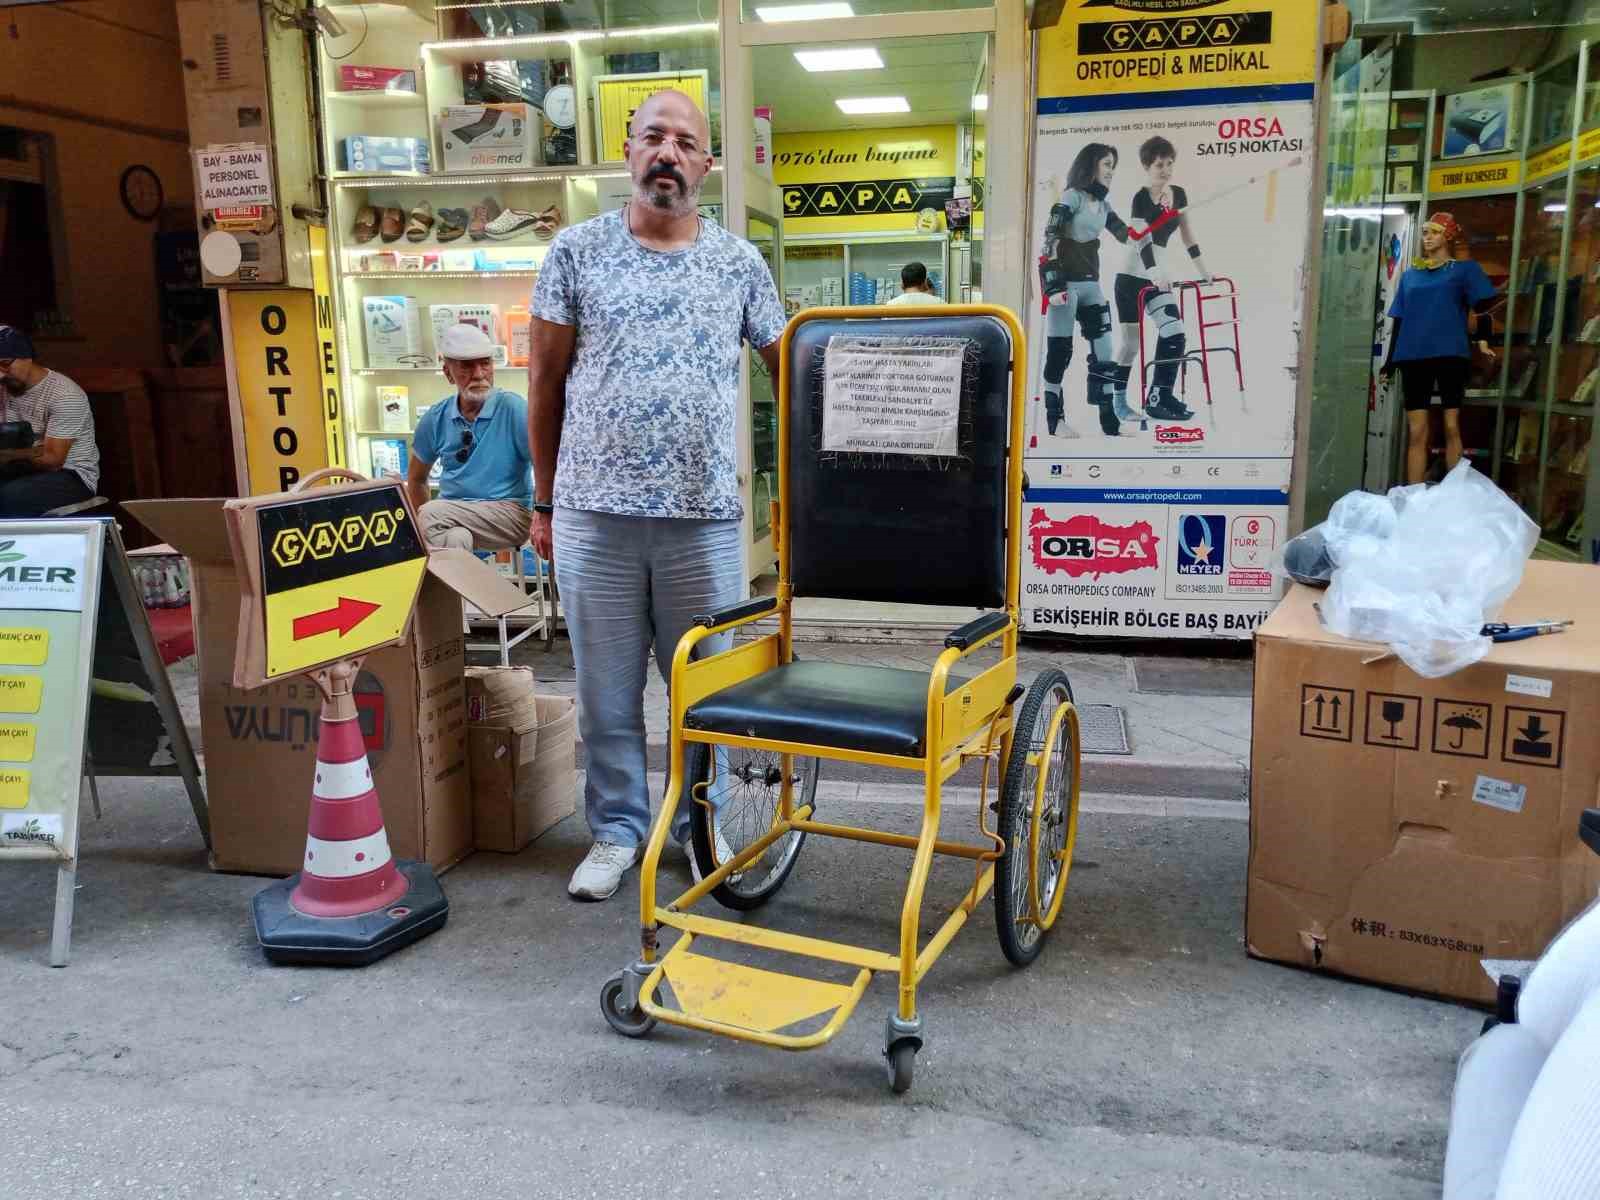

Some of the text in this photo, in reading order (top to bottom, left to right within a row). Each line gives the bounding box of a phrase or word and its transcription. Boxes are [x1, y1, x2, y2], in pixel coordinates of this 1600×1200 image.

[1113, 23, 1231, 47] ÇAPA
[1076, 48, 1270, 80] ORTOPEDİ & MEDİKAL
[1218, 117, 1284, 140] ORSA
[1197, 139, 1303, 157] SATIŞ NOKTASI
[203, 155, 220, 167] BAY
[229, 153, 262, 165] BAYAN
[209, 170, 260, 182] PERSONEL
[205, 185, 267, 199] ALINACAKTIR
[784, 187, 912, 211] ÇAPA
[1103, 491, 1202, 502] www.orsaortopedi.com
[283, 518, 389, 560] ÇAPA
[1042, 536, 1148, 560] ORSA
[1233, 537, 1258, 547] TÜRK
[1179, 565, 1221, 574] MEYER
[1026, 584, 1156, 598] ORSA ORTHOPEDICS COMPANY
[1033, 607, 1119, 629] ESKİŞEHİR
[1124, 610, 1180, 629] BÖLGE
[1185, 614, 1218, 632] BAŞ
